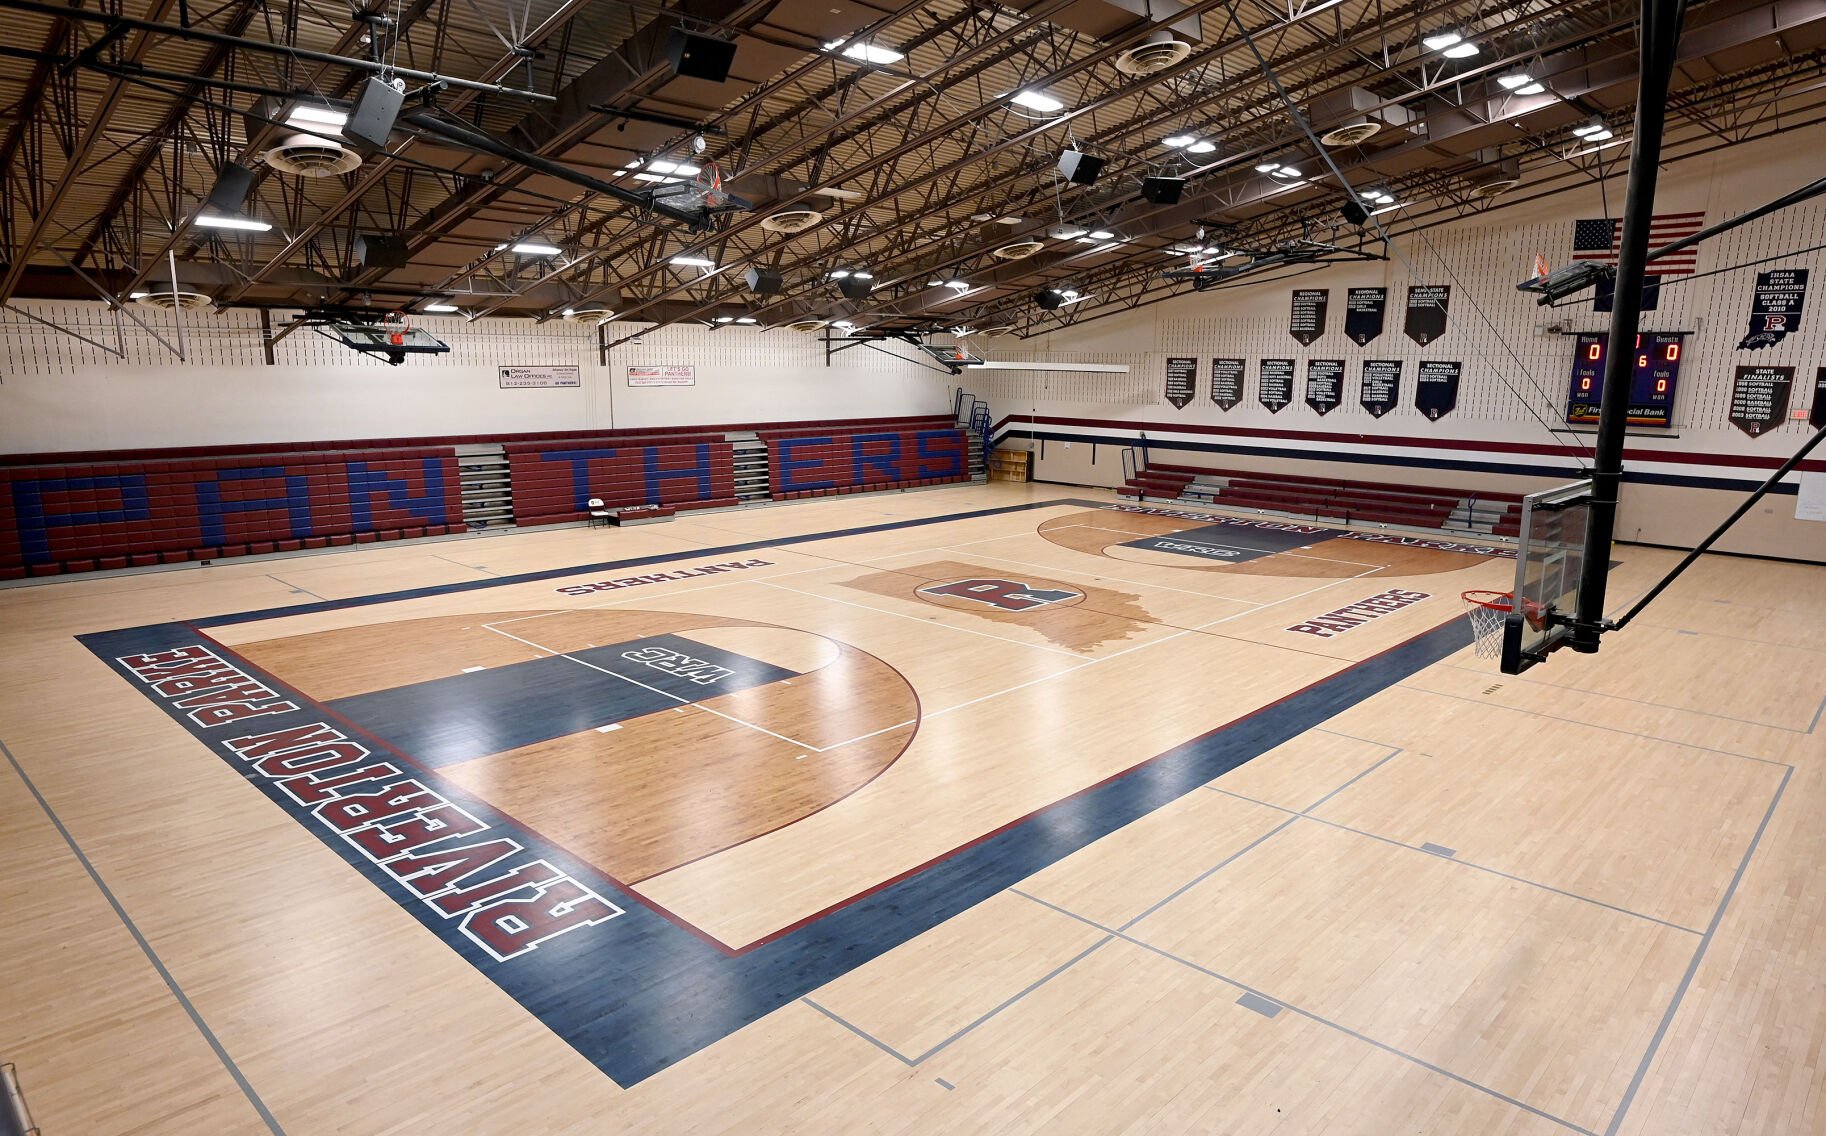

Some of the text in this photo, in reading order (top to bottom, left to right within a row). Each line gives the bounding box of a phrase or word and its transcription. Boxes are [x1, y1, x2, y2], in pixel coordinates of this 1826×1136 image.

[1589, 344, 1600, 360] 0
[1666, 344, 1679, 361] 0
[1638, 355, 1647, 367] 6
[1582, 378, 1591, 390] 0
[1657, 379, 1666, 392] 0
[1644, 408, 1665, 416] Bank
[554, 558, 777, 596] PANTHERS
[916, 578, 1084, 612] R
[1284, 588, 1433, 638] PANTHERS
[620, 646, 736, 685] WRC
[115, 644, 626, 963] RIVERTON PARKE
